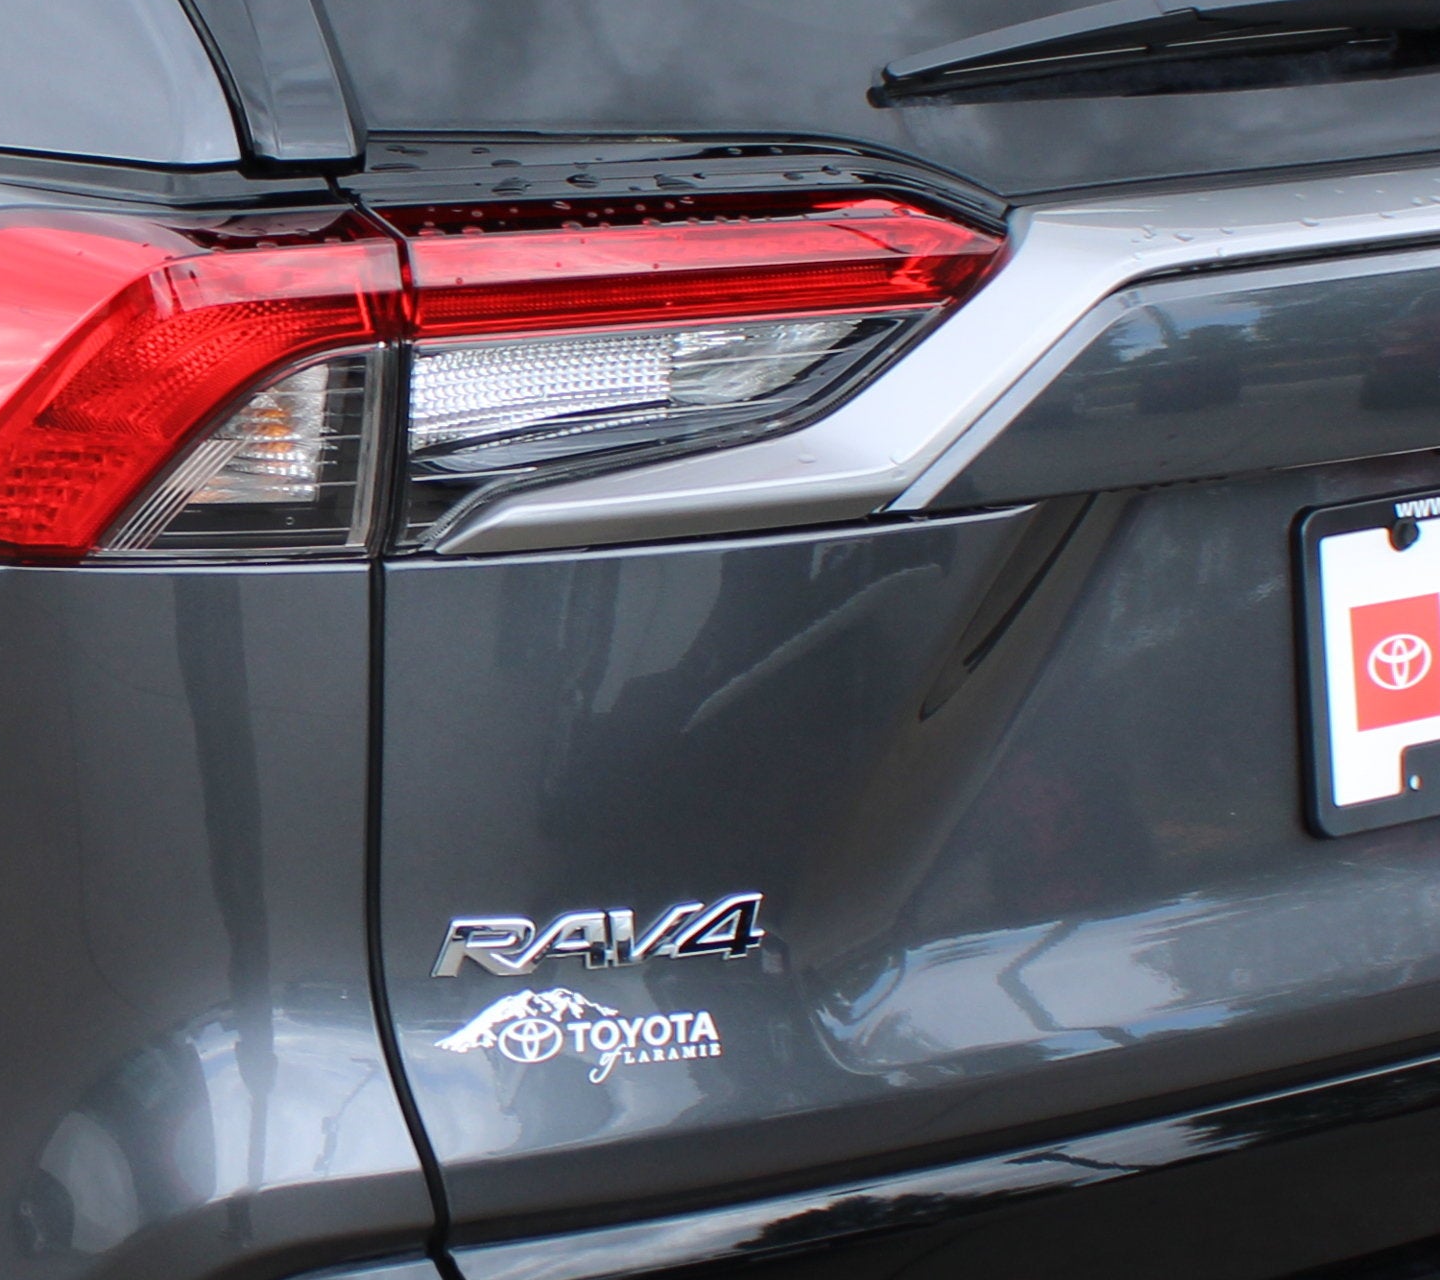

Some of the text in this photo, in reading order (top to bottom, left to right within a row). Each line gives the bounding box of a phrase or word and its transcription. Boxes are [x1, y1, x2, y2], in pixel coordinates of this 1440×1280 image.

[430, 891, 766, 979] RAV4
[567, 1010, 720, 1053] TOYOTA
[589, 1042, 722, 1084] of LARAMIE
